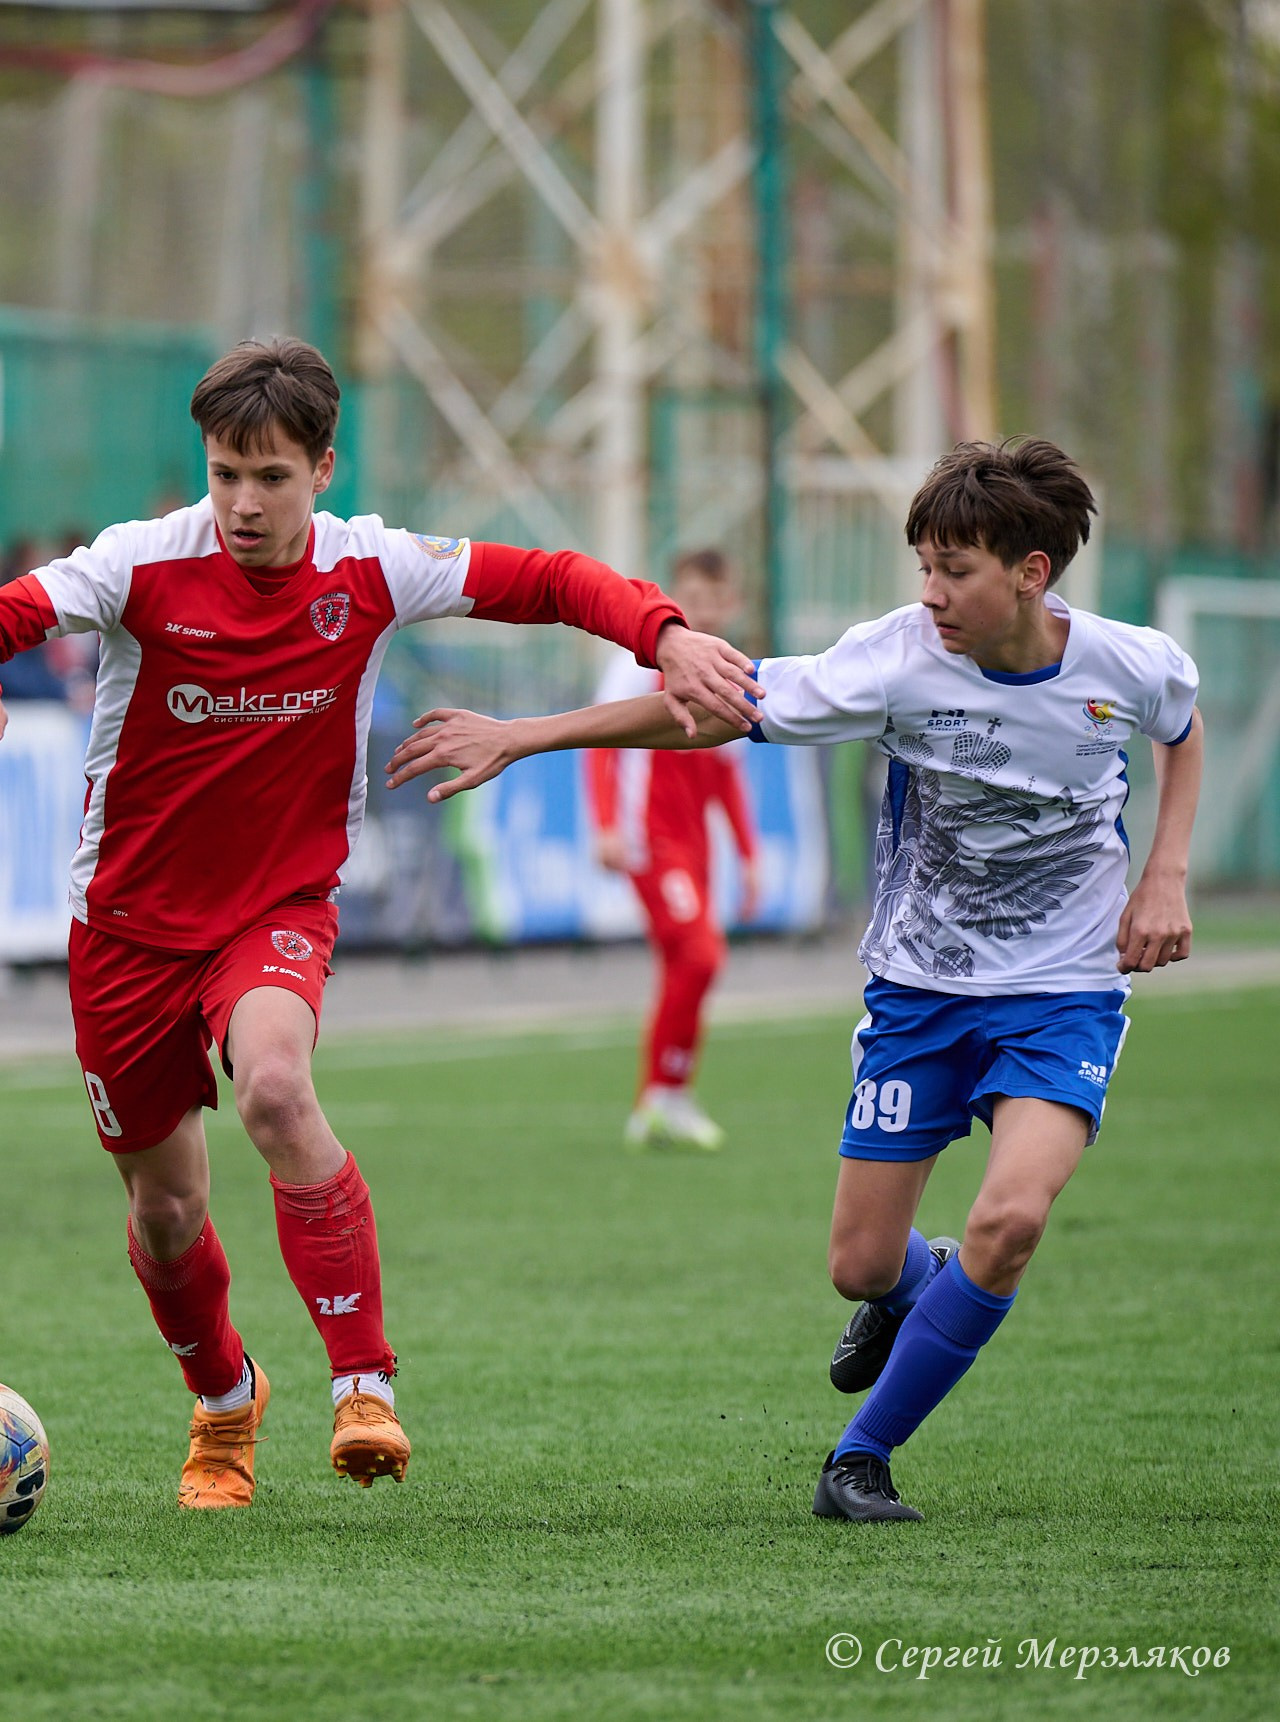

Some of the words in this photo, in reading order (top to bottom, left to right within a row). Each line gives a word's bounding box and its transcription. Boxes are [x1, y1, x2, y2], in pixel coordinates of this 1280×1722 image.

[165, 622, 183, 633] 2K
[181, 627, 217, 639] SPORT
[213, 716, 274, 724] СИСТЕМНАЯ
[927, 719, 969, 727] SPORT
[261, 965, 279, 973] 2K
[851, 1078, 913, 1133] 89
